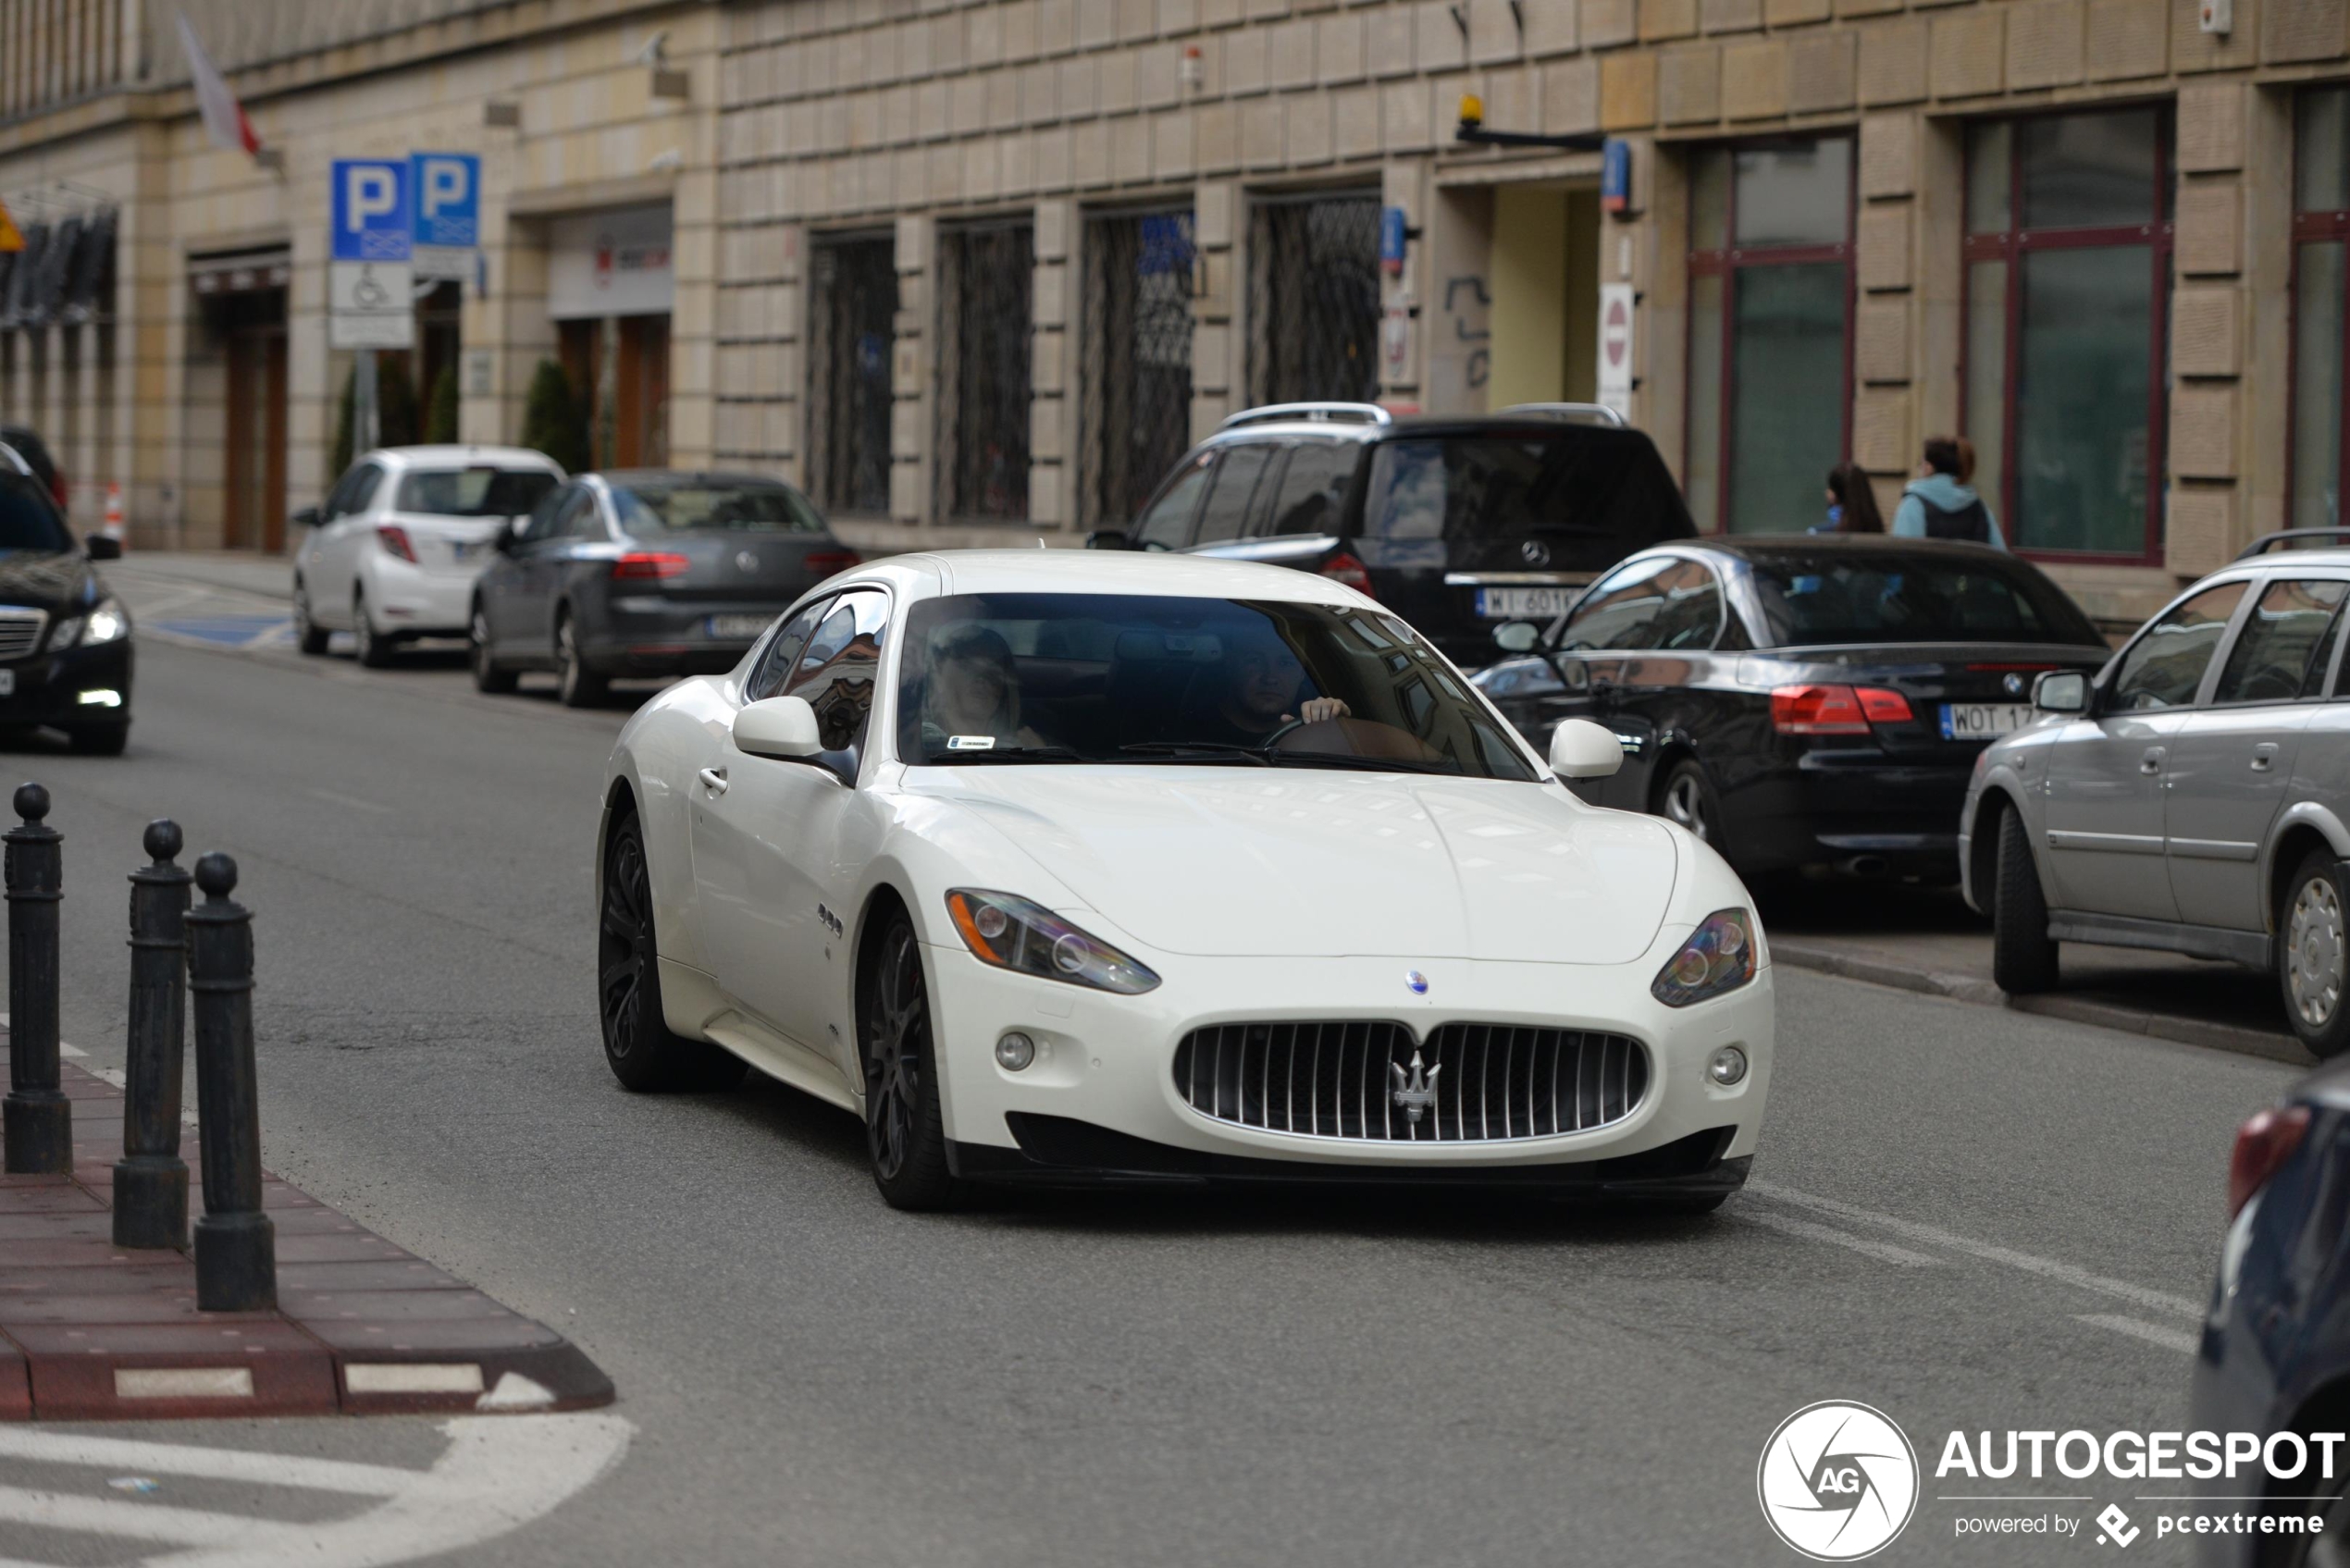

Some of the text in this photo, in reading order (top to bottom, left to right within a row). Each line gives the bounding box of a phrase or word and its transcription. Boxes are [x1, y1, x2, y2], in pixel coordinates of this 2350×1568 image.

[347, 165, 398, 233] P
[422, 159, 468, 220] P
[1953, 707, 1997, 731] WOT
